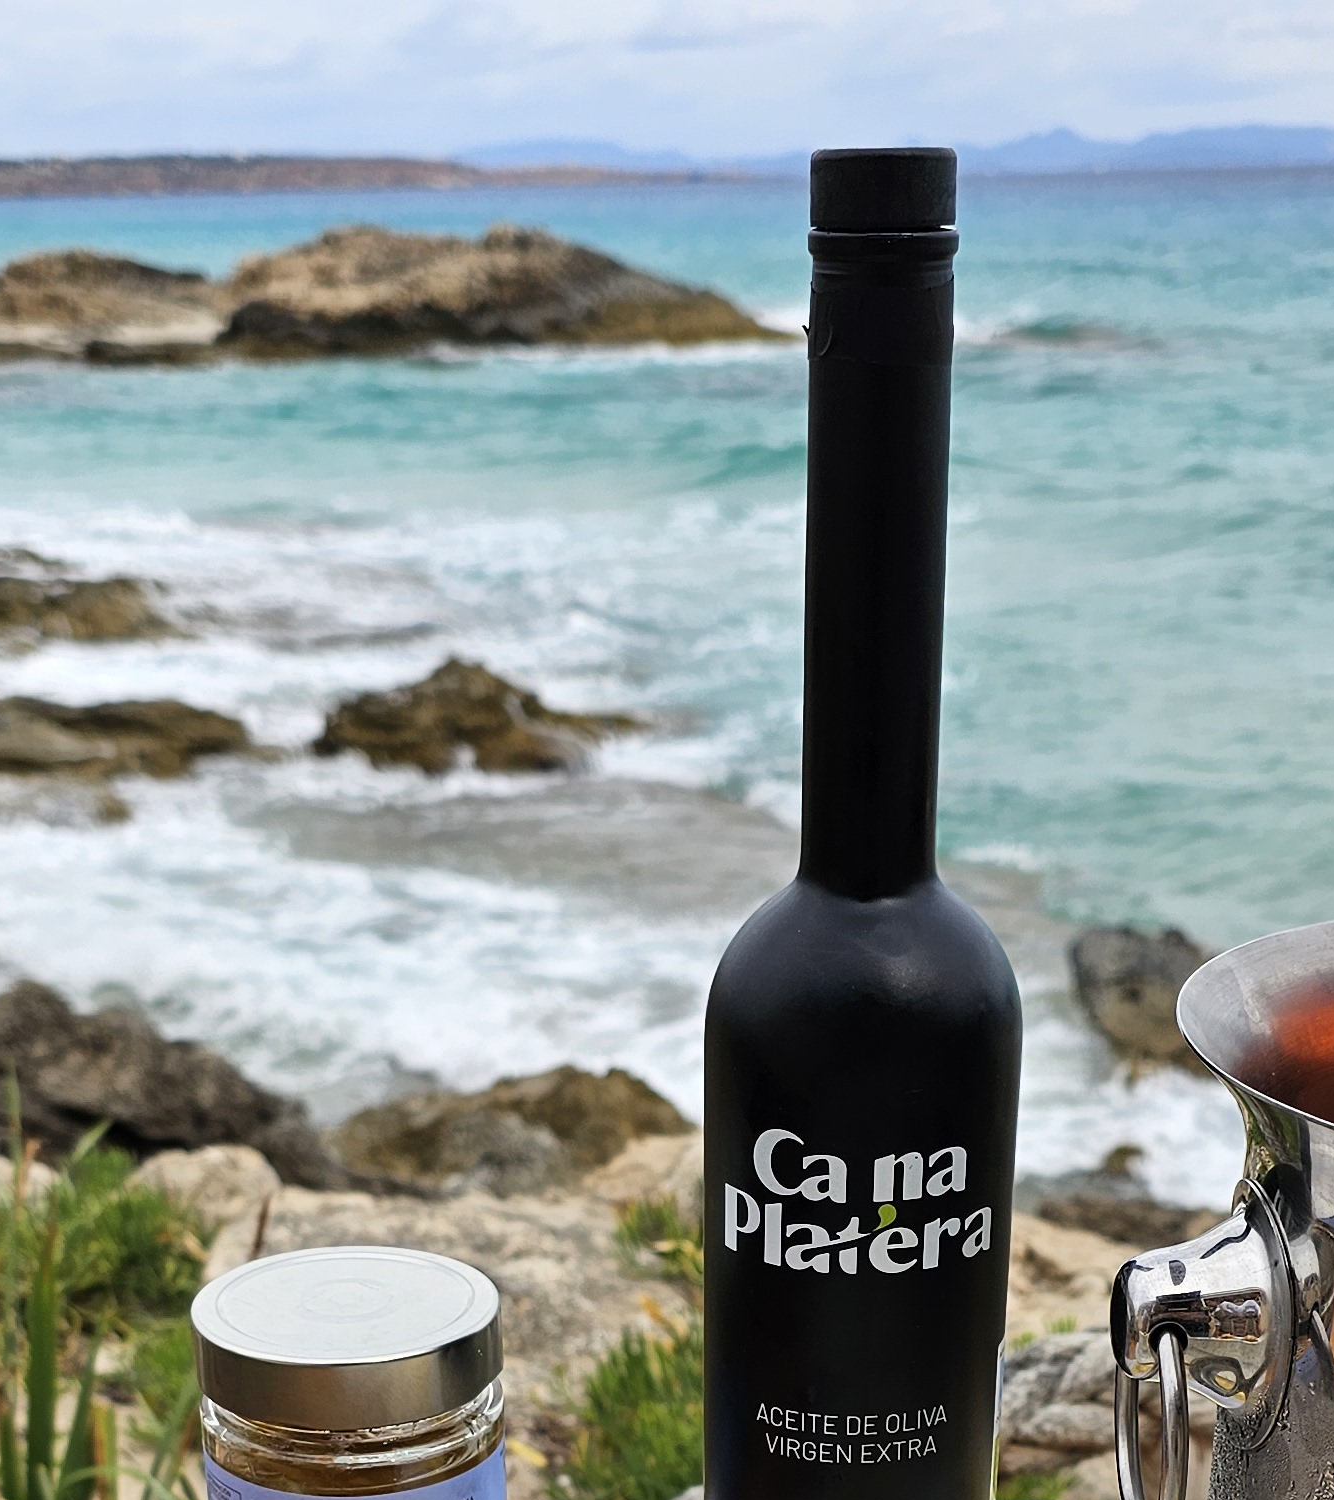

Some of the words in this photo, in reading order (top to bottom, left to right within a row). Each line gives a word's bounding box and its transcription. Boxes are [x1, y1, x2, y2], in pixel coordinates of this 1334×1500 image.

[753, 1128, 847, 1203] Ca
[873, 1146, 967, 1202] na
[756, 1402, 838, 1436] ACEITE
[846, 1415, 877, 1436] DE
[885, 1404, 948, 1433] OLIVA
[765, 1432, 852, 1464] VIRGEN
[861, 1435, 937, 1464] EXTRA
